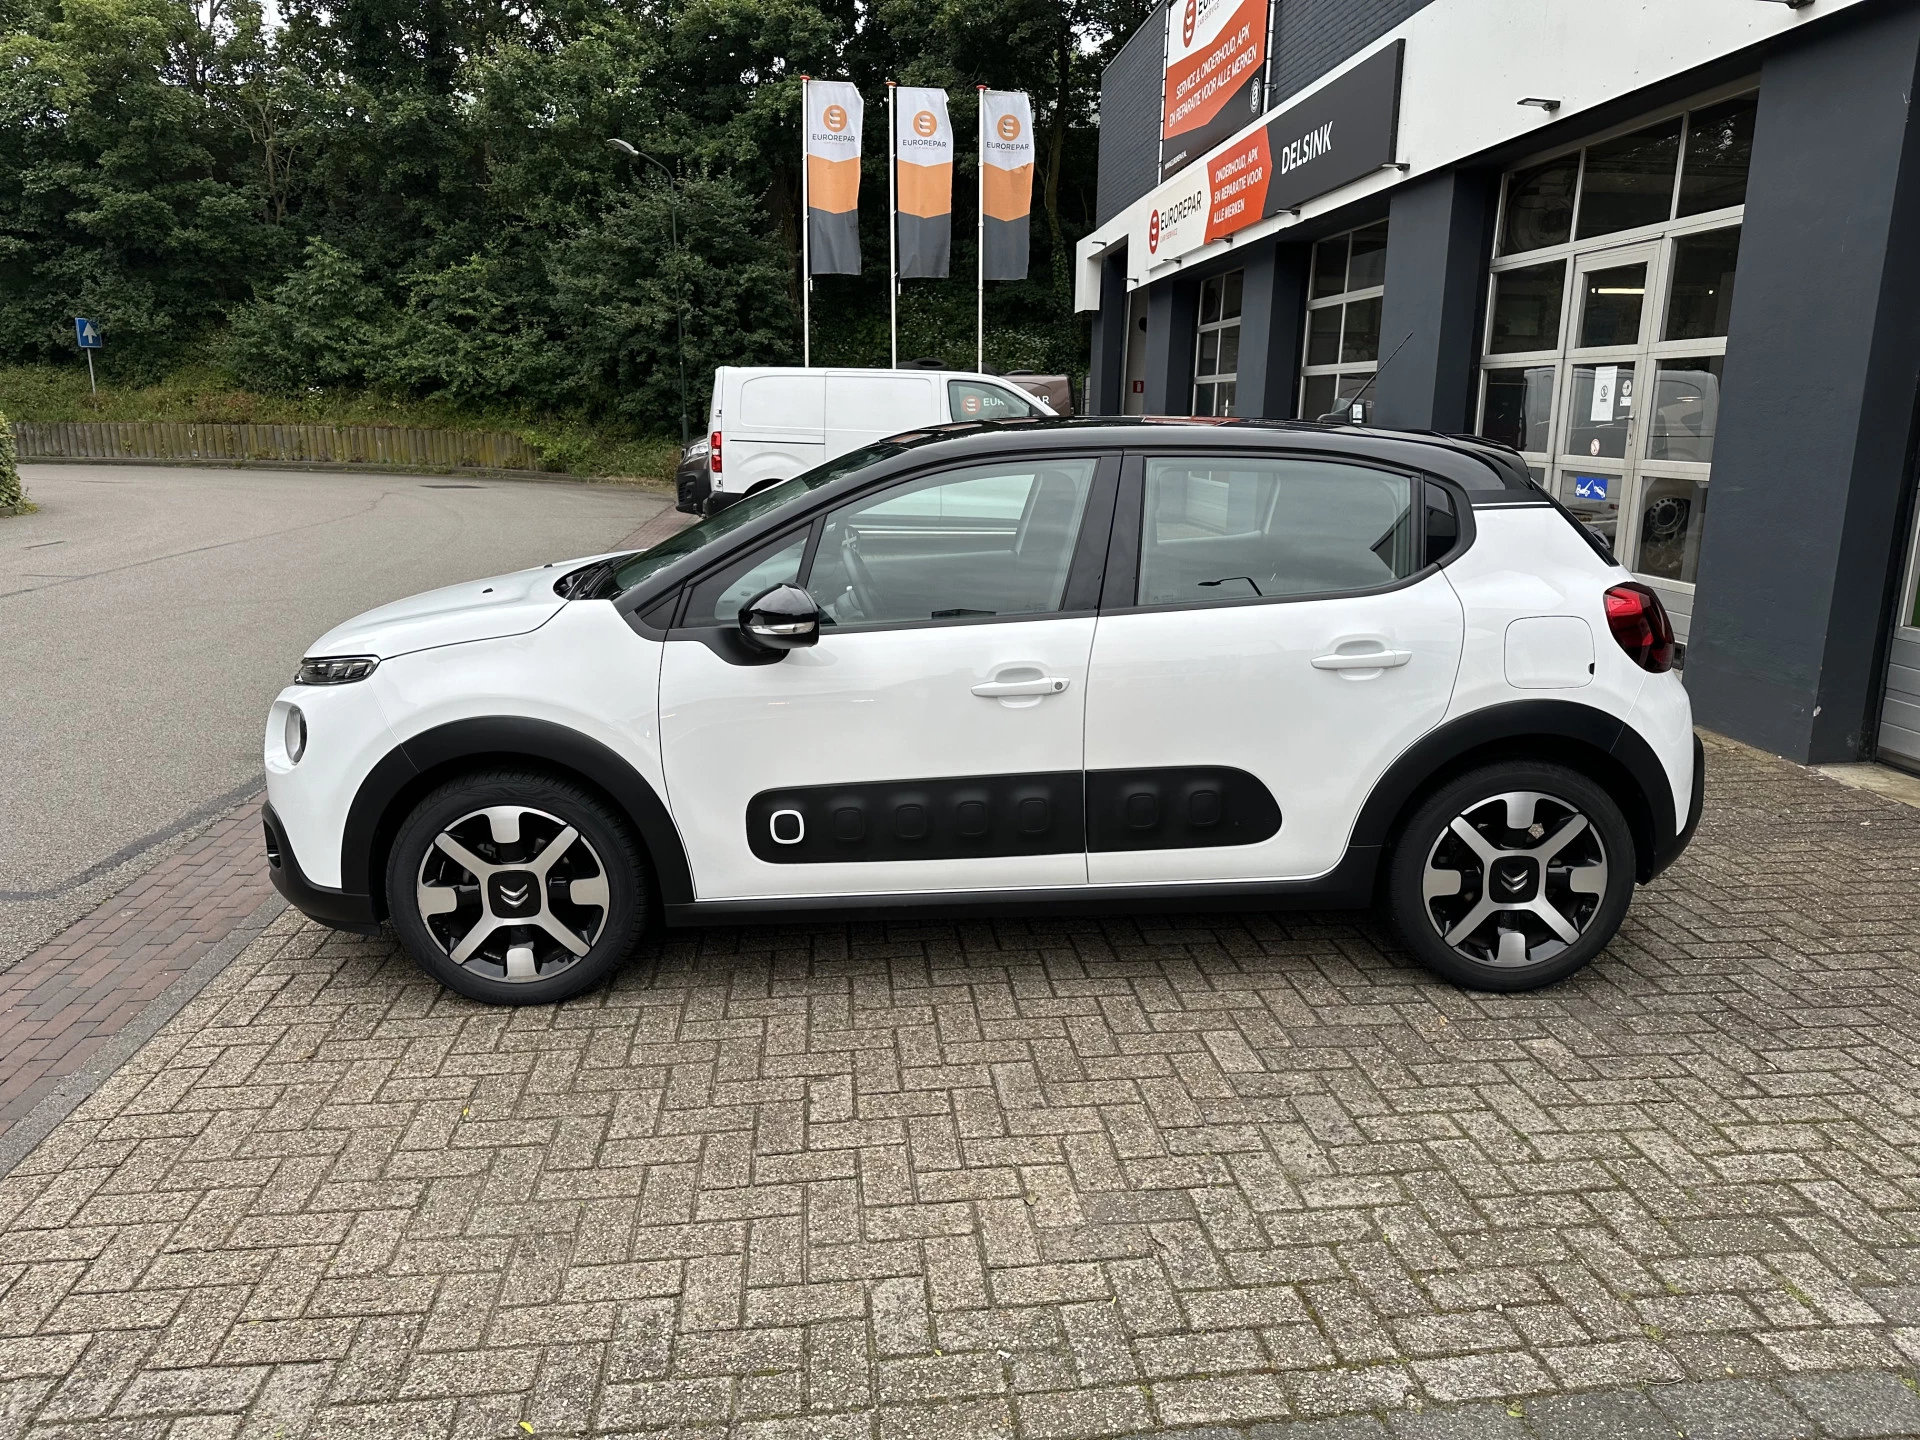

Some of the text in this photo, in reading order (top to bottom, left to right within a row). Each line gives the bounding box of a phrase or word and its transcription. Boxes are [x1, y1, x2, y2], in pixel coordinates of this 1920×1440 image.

[1176, 71, 1196, 100] SERVICE
[1237, 22, 1251, 48] APK
[1201, 77, 1219, 101] VOOR
[1217, 64, 1232, 89] ALLE
[1231, 42, 1258, 77] MERKEN
[812, 133, 856, 142] EUROREPAR
[902, 139, 947, 148] EUROREPAR
[986, 141, 1030, 150] EUROREPAR
[1281, 120, 1332, 175] DELSINK
[1246, 146, 1259, 166] APK
[1220, 175, 1247, 201] REPARATIE
[1246, 166, 1263, 187] VOOR
[1160, 190, 1202, 231] EUROREPAR
[1213, 198, 1245, 225] ALLE MERKEN
